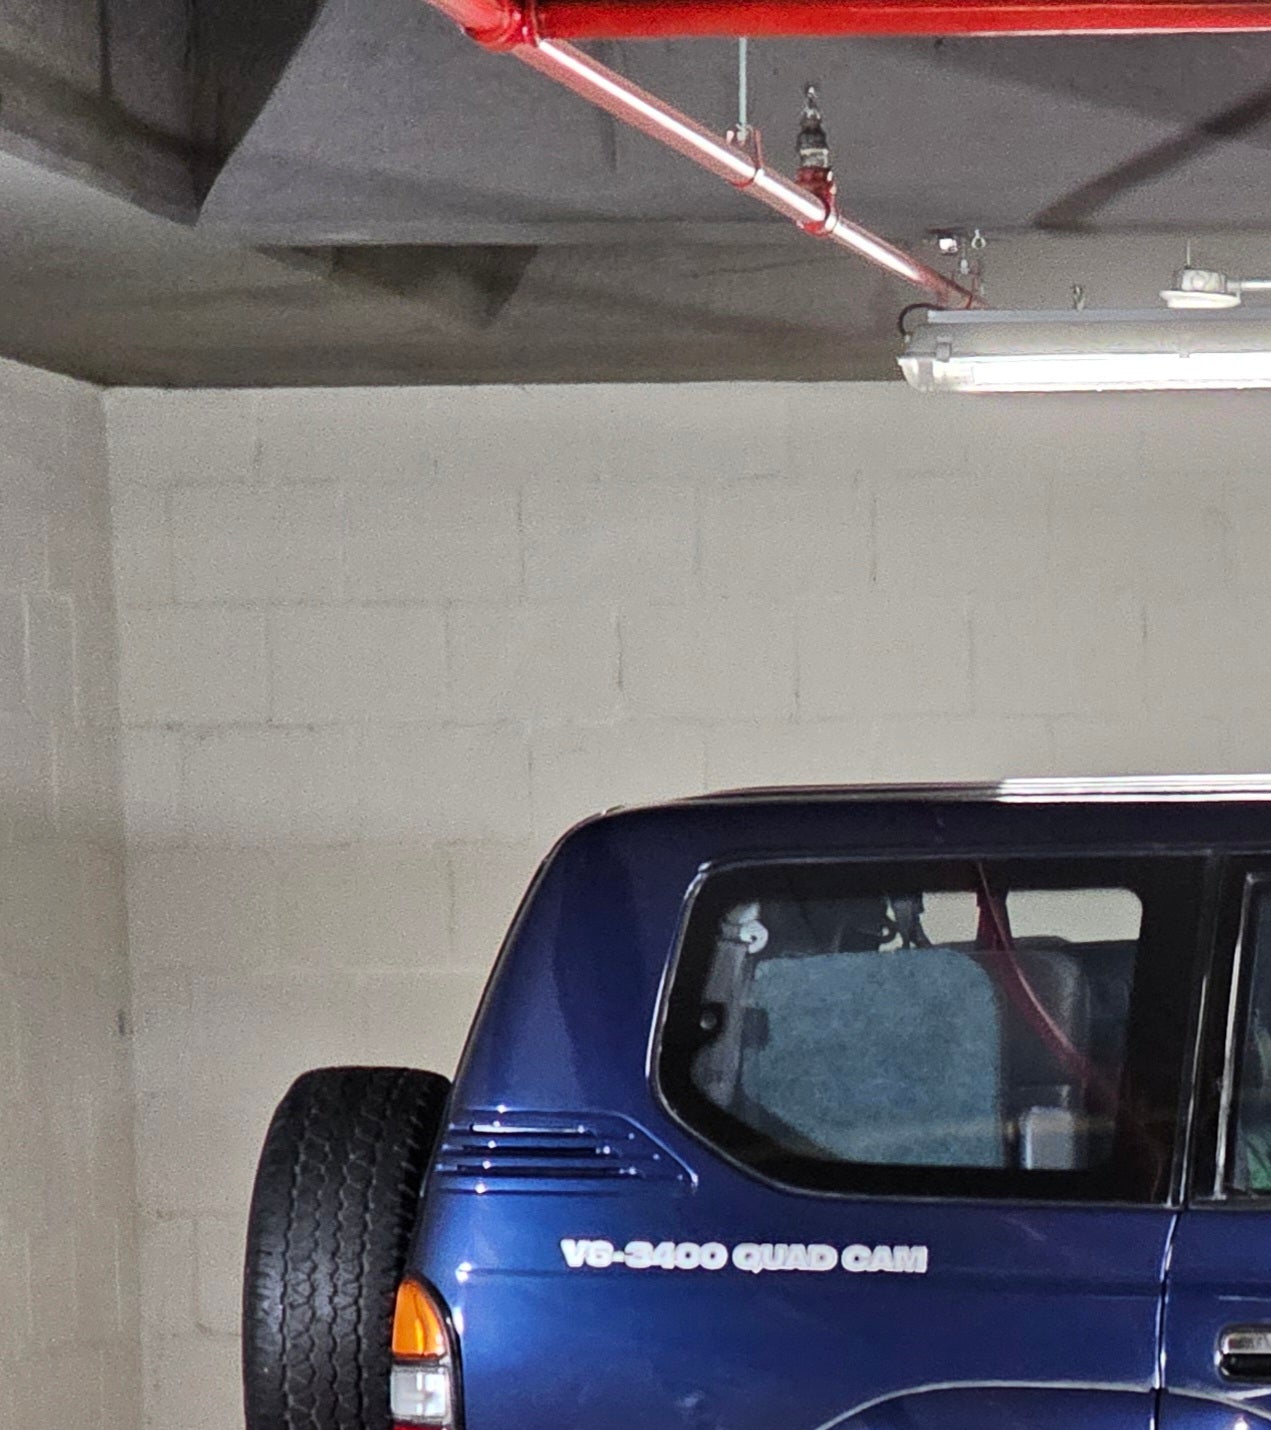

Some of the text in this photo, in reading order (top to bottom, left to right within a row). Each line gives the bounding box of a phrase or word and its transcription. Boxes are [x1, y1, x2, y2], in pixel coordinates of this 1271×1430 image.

[560, 1238, 928, 1274] V6-3400 QUAD CAM
